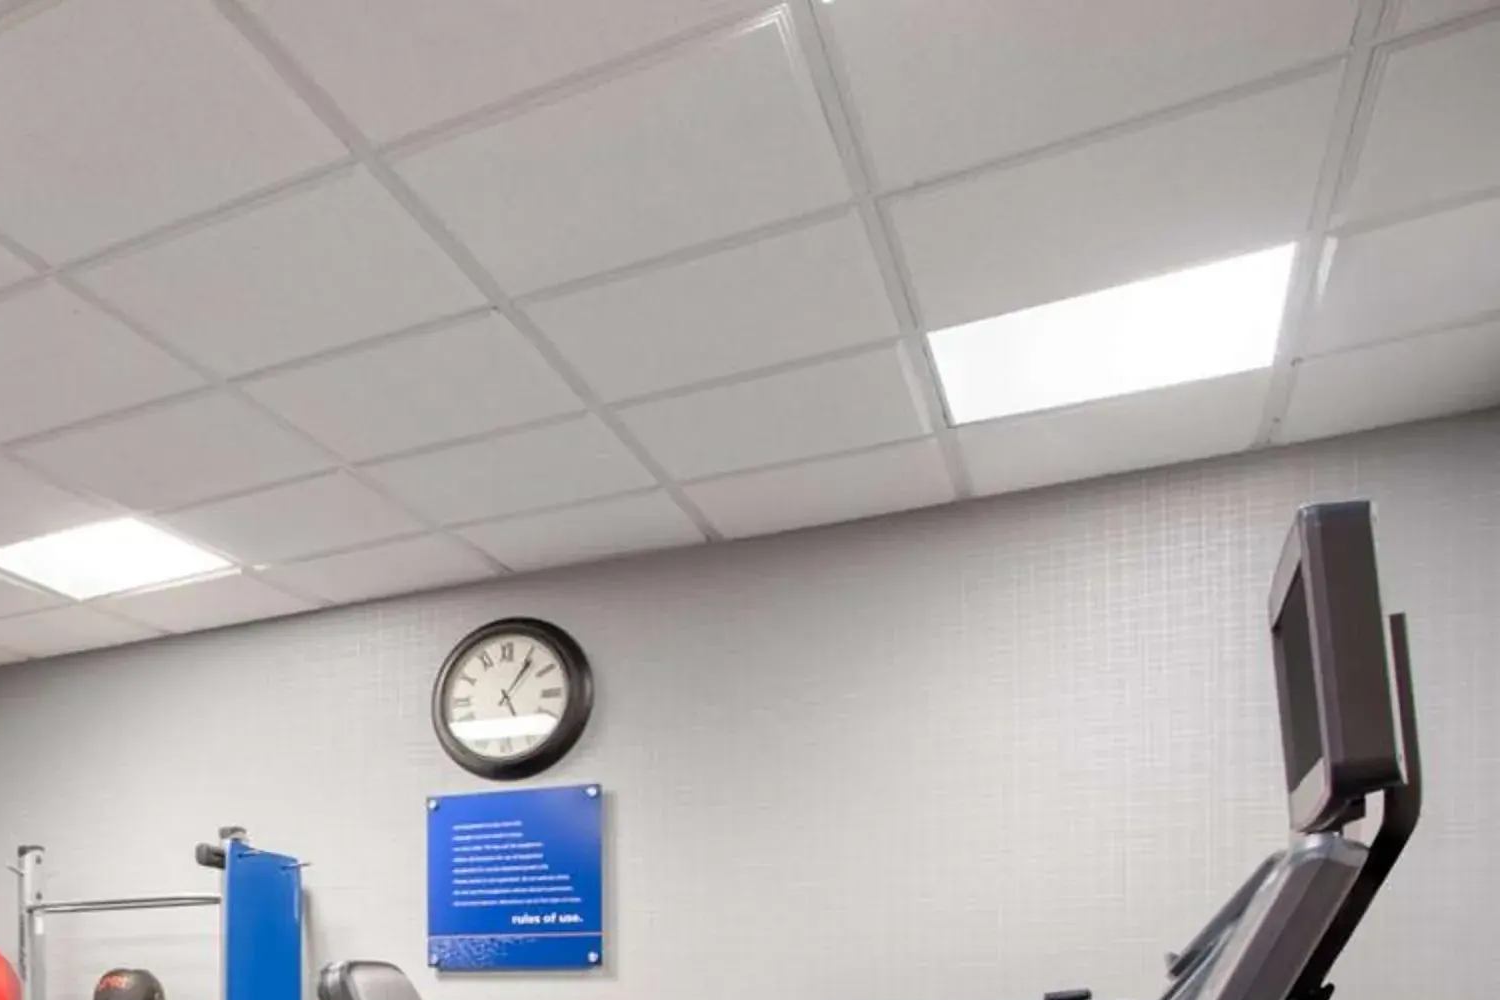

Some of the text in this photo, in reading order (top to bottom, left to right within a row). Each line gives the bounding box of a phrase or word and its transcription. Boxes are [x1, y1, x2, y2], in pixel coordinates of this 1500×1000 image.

[511, 911, 584, 925] rules of use.
